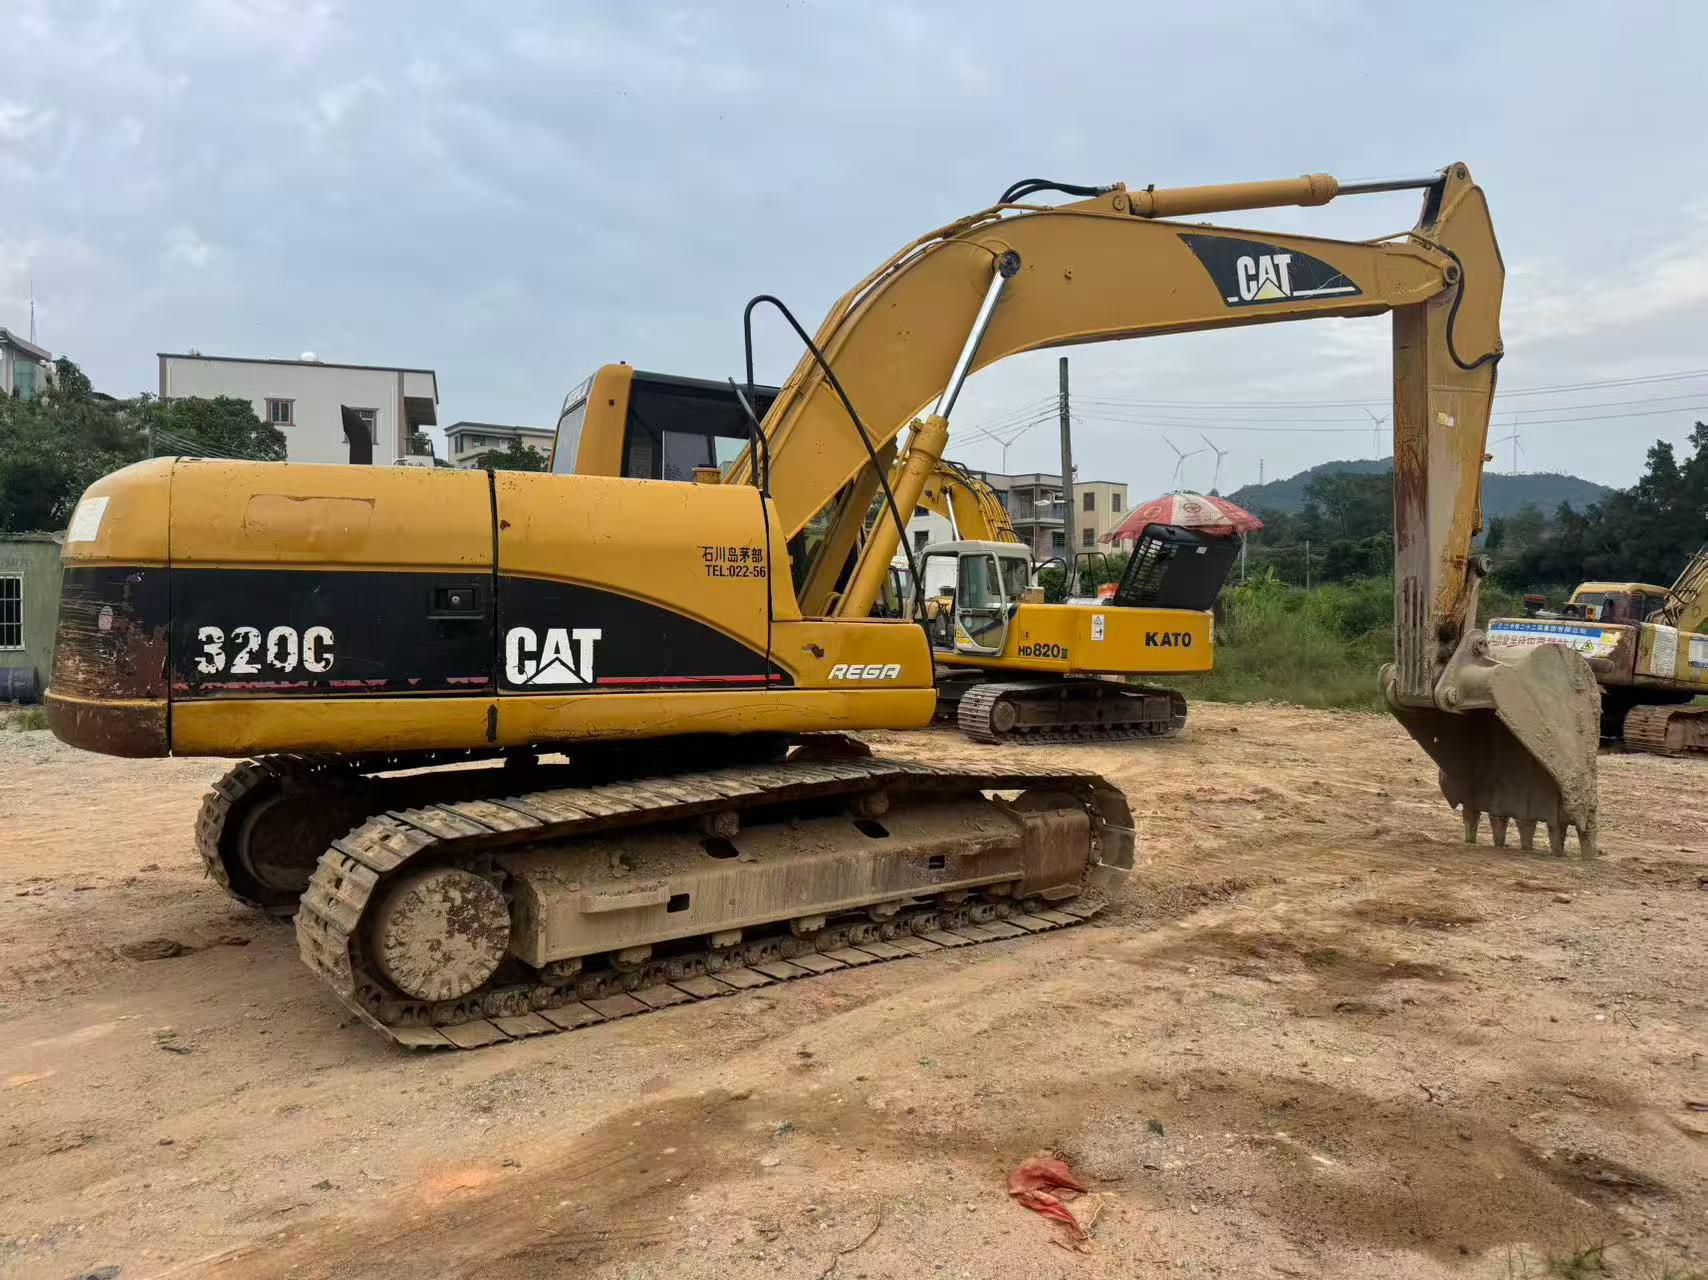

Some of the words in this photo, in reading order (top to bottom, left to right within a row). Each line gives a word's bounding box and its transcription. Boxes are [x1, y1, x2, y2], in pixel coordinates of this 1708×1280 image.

[1236, 254, 1292, 301] CAT
[697, 546, 763, 563] 石川岛茅部
[195, 626, 335, 674] 320C
[1145, 632, 1192, 647] KATO
[505, 627, 602, 685] CAT
[828, 664, 901, 680] REGA
